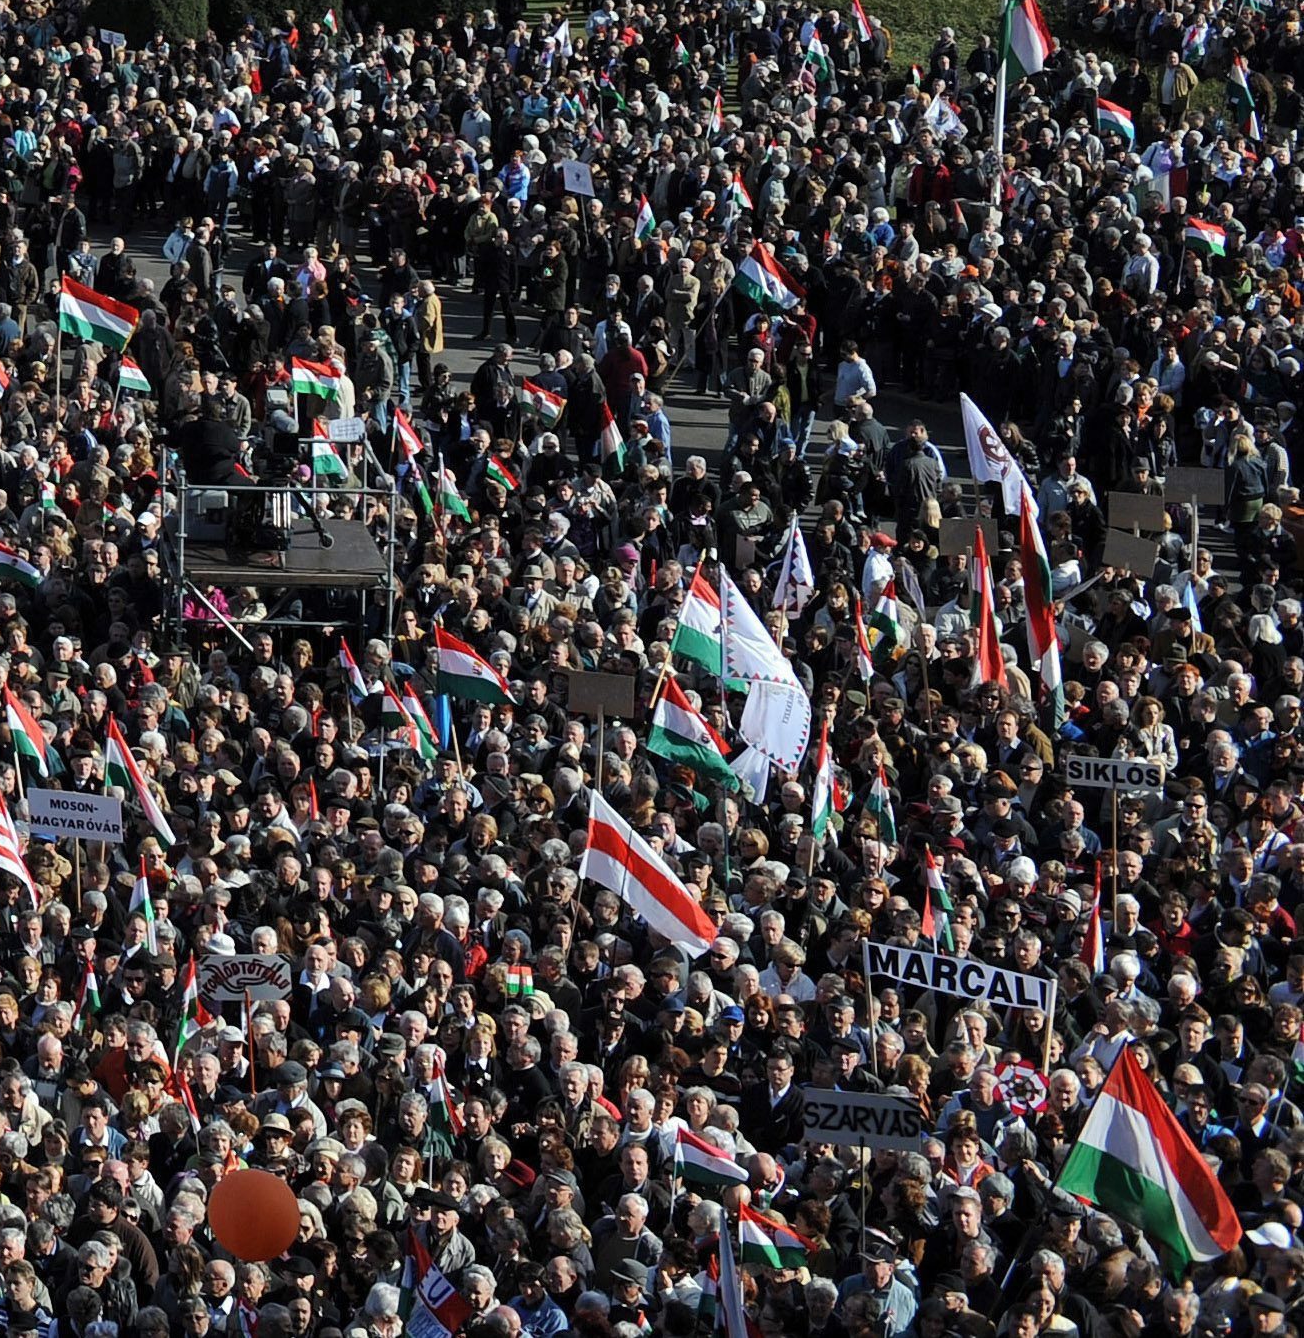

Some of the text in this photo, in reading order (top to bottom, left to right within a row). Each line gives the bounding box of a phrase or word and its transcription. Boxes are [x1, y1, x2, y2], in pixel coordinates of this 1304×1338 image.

[1067, 761, 1161, 787] SIKLÓS
[50, 798, 100, 814] MOSON-
[30, 814, 121, 835] MAGYARÓVÁR
[868, 945, 1047, 1011] MARCALI
[802, 1101, 921, 1138] SZARVAS
